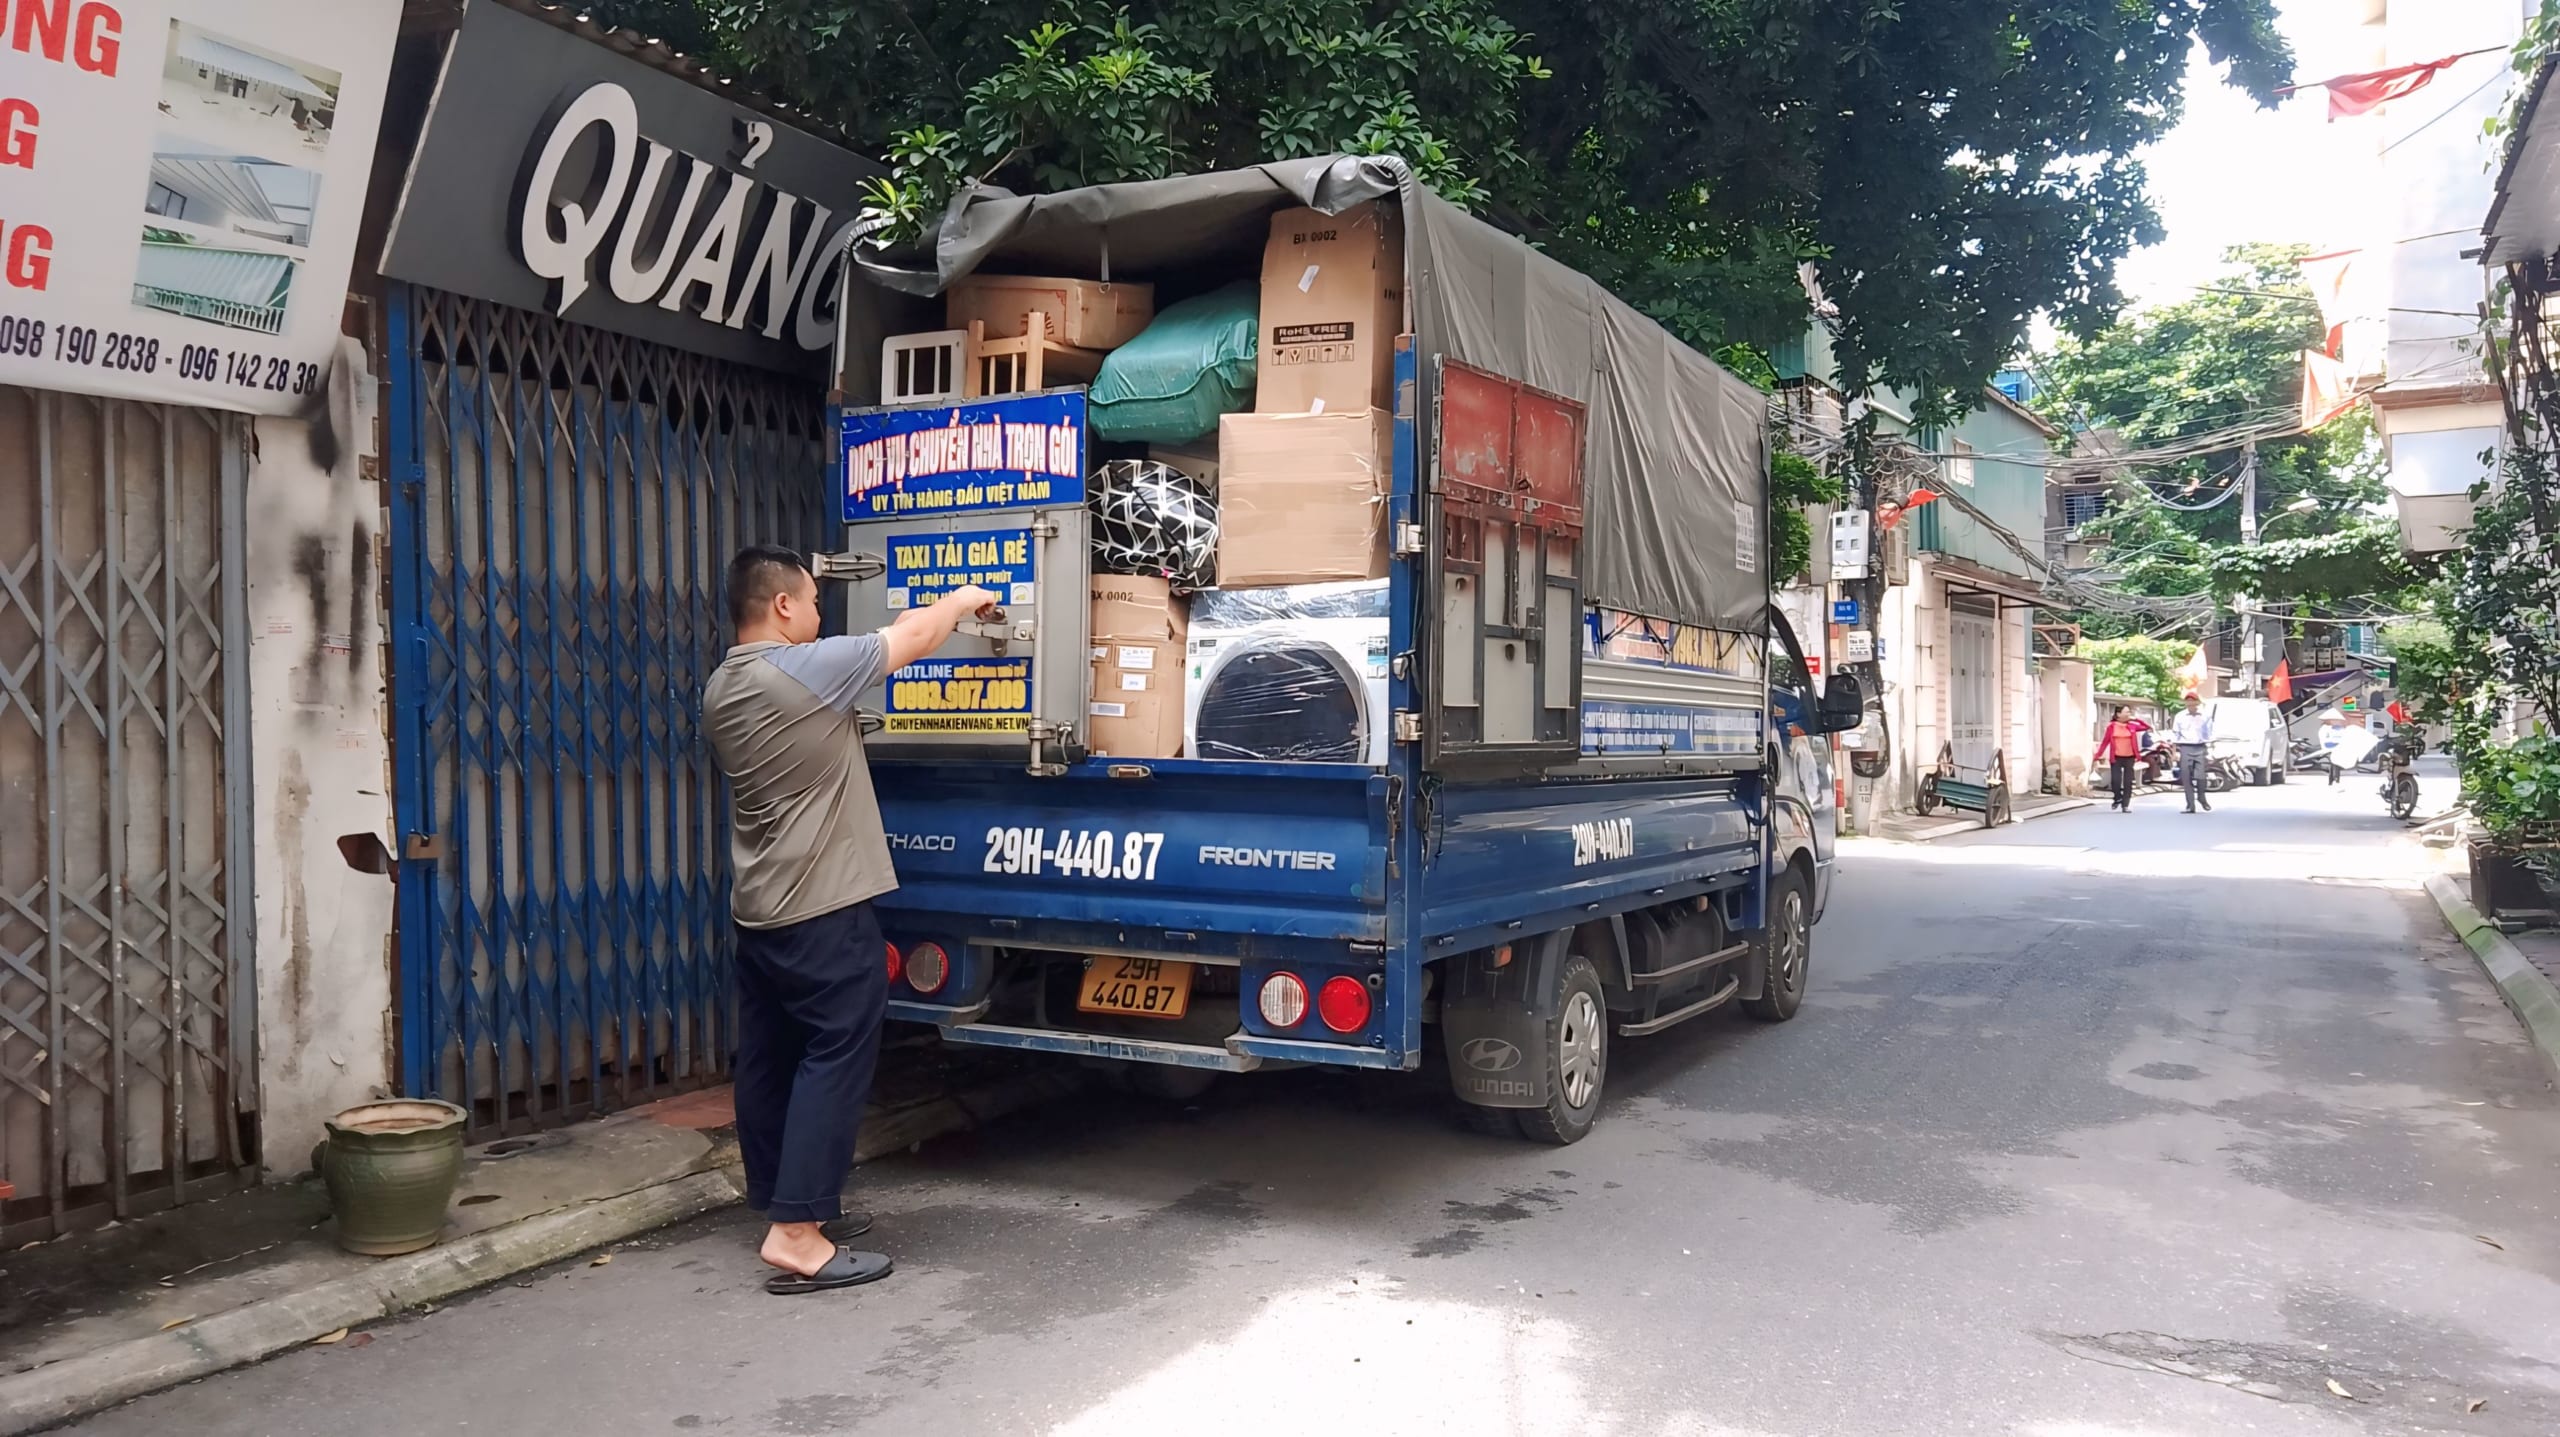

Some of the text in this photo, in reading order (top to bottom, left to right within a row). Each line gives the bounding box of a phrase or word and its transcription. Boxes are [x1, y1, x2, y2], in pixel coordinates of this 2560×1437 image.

[522, 83, 848, 350] QUẢNG
[0, 219, 53, 291] G
[1279, 327, 1310, 337] RoHS
[1313, 324, 1347, 334] FREE
[0, 315, 45, 358] 098
[55, 324, 97, 365] 190
[101, 332, 159, 374] 2838
[179, 343, 219, 382] 096
[226, 351, 262, 388] 142
[263, 357, 290, 392] 28
[293, 361, 318, 394] 38
[848, 408, 1078, 503] DỊCH VỤ CHUYỂN NHÀ TRỌN GÓI
[872, 494, 888, 512] UY
[916, 487, 953, 509] HÀNG
[986, 481, 1014, 506] VIỆT
[1017, 481, 1050, 500] NAM
[895, 532, 1027, 569] TAXI TẢI GIÁ RẺ
[1107, 591, 1134, 602] 0002
[893, 664, 952, 679] HOTLINE
[983, 827, 1165, 881] 29H-440.87
[1199, 846, 1336, 871] FRONTIER
[1115, 958, 1161, 981] 29H
[1091, 981, 1175, 1012] 440.87
